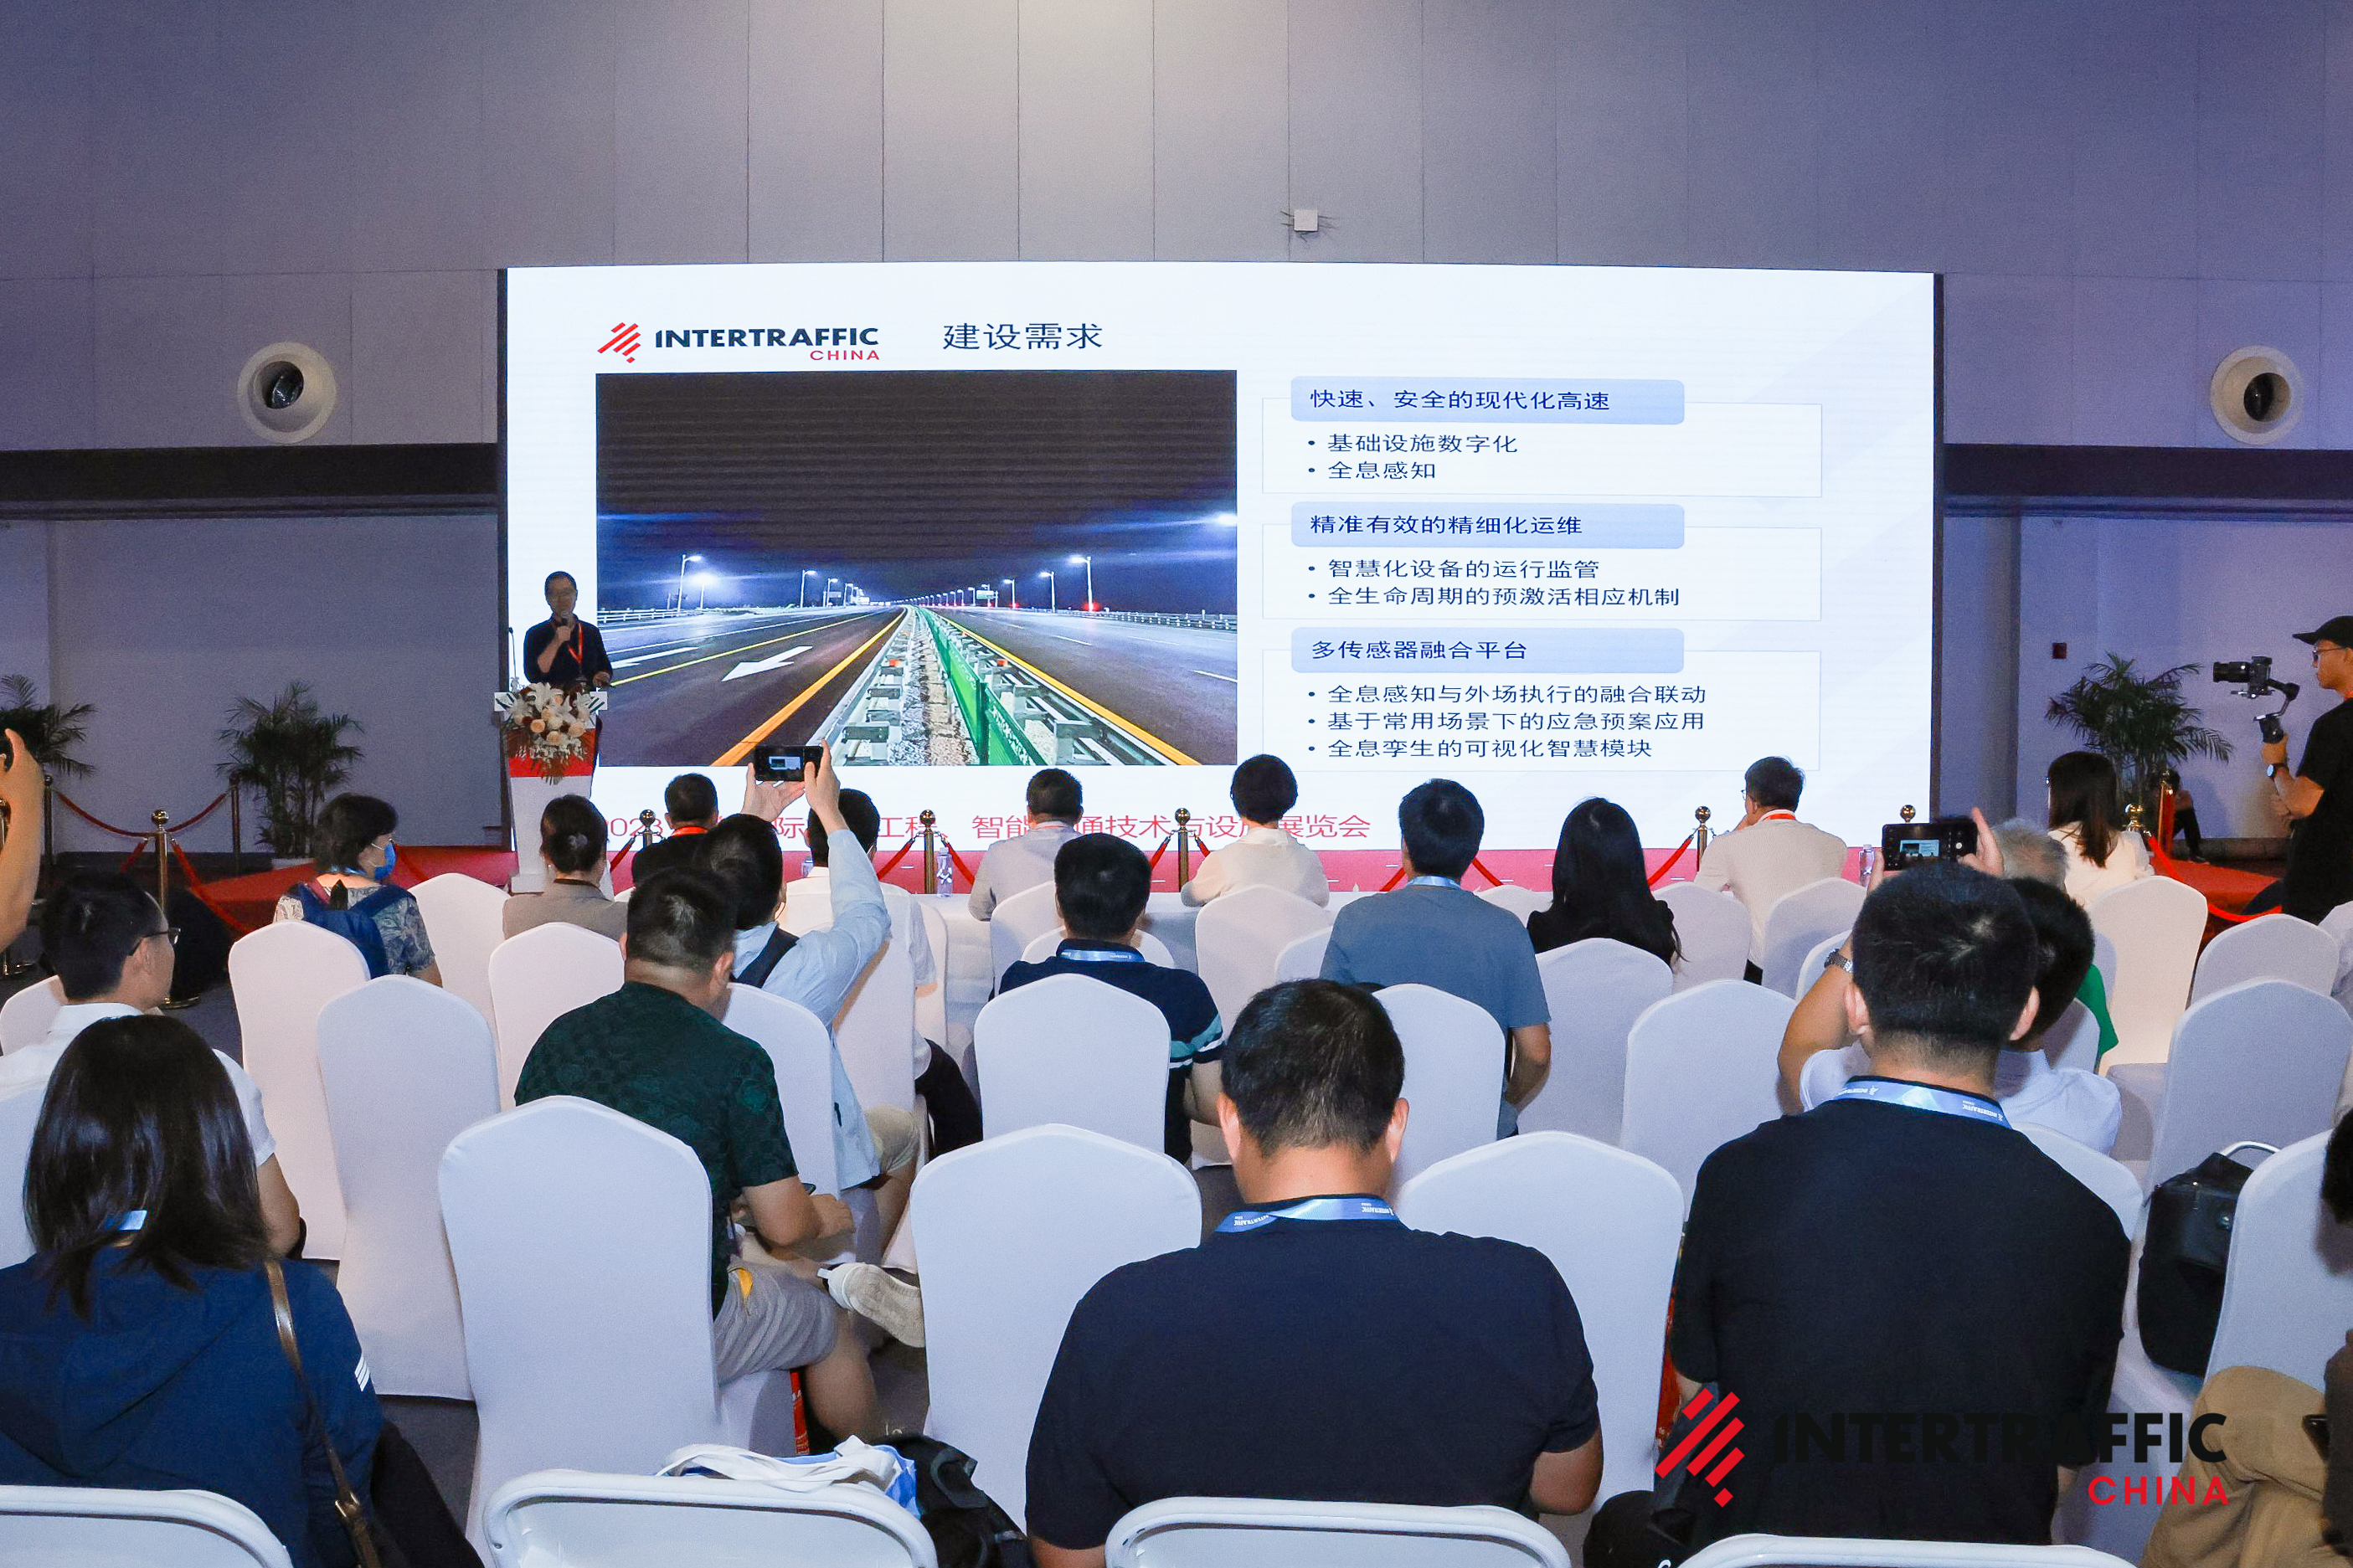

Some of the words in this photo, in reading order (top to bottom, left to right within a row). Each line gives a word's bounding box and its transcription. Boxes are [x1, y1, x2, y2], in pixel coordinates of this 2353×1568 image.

[656, 328, 879, 348] INTERTRAFFIC
[943, 323, 1103, 350] 建设需求
[811, 350, 880, 361] CHINA
[1310, 389, 1610, 410] 快速、安全的现代化高速
[1328, 434, 1518, 453] 基础设施数字化
[1328, 461, 1435, 480] 全息感知
[1310, 515, 1583, 535] 精准有效的精细化运维
[1329, 559, 1599, 579] 智慧化设备的运行监管
[1328, 587, 1679, 606] 全生命周期的预激活相应机制
[1312, 640, 1527, 660] 多传感器融合平台
[1328, 685, 1706, 704] 全息感知与外场执行的融合联动
[1328, 712, 1704, 731] 基于常用场景下的应急预案应用
[1328, 739, 1652, 758] 全息孪生的可视化智慧模块
